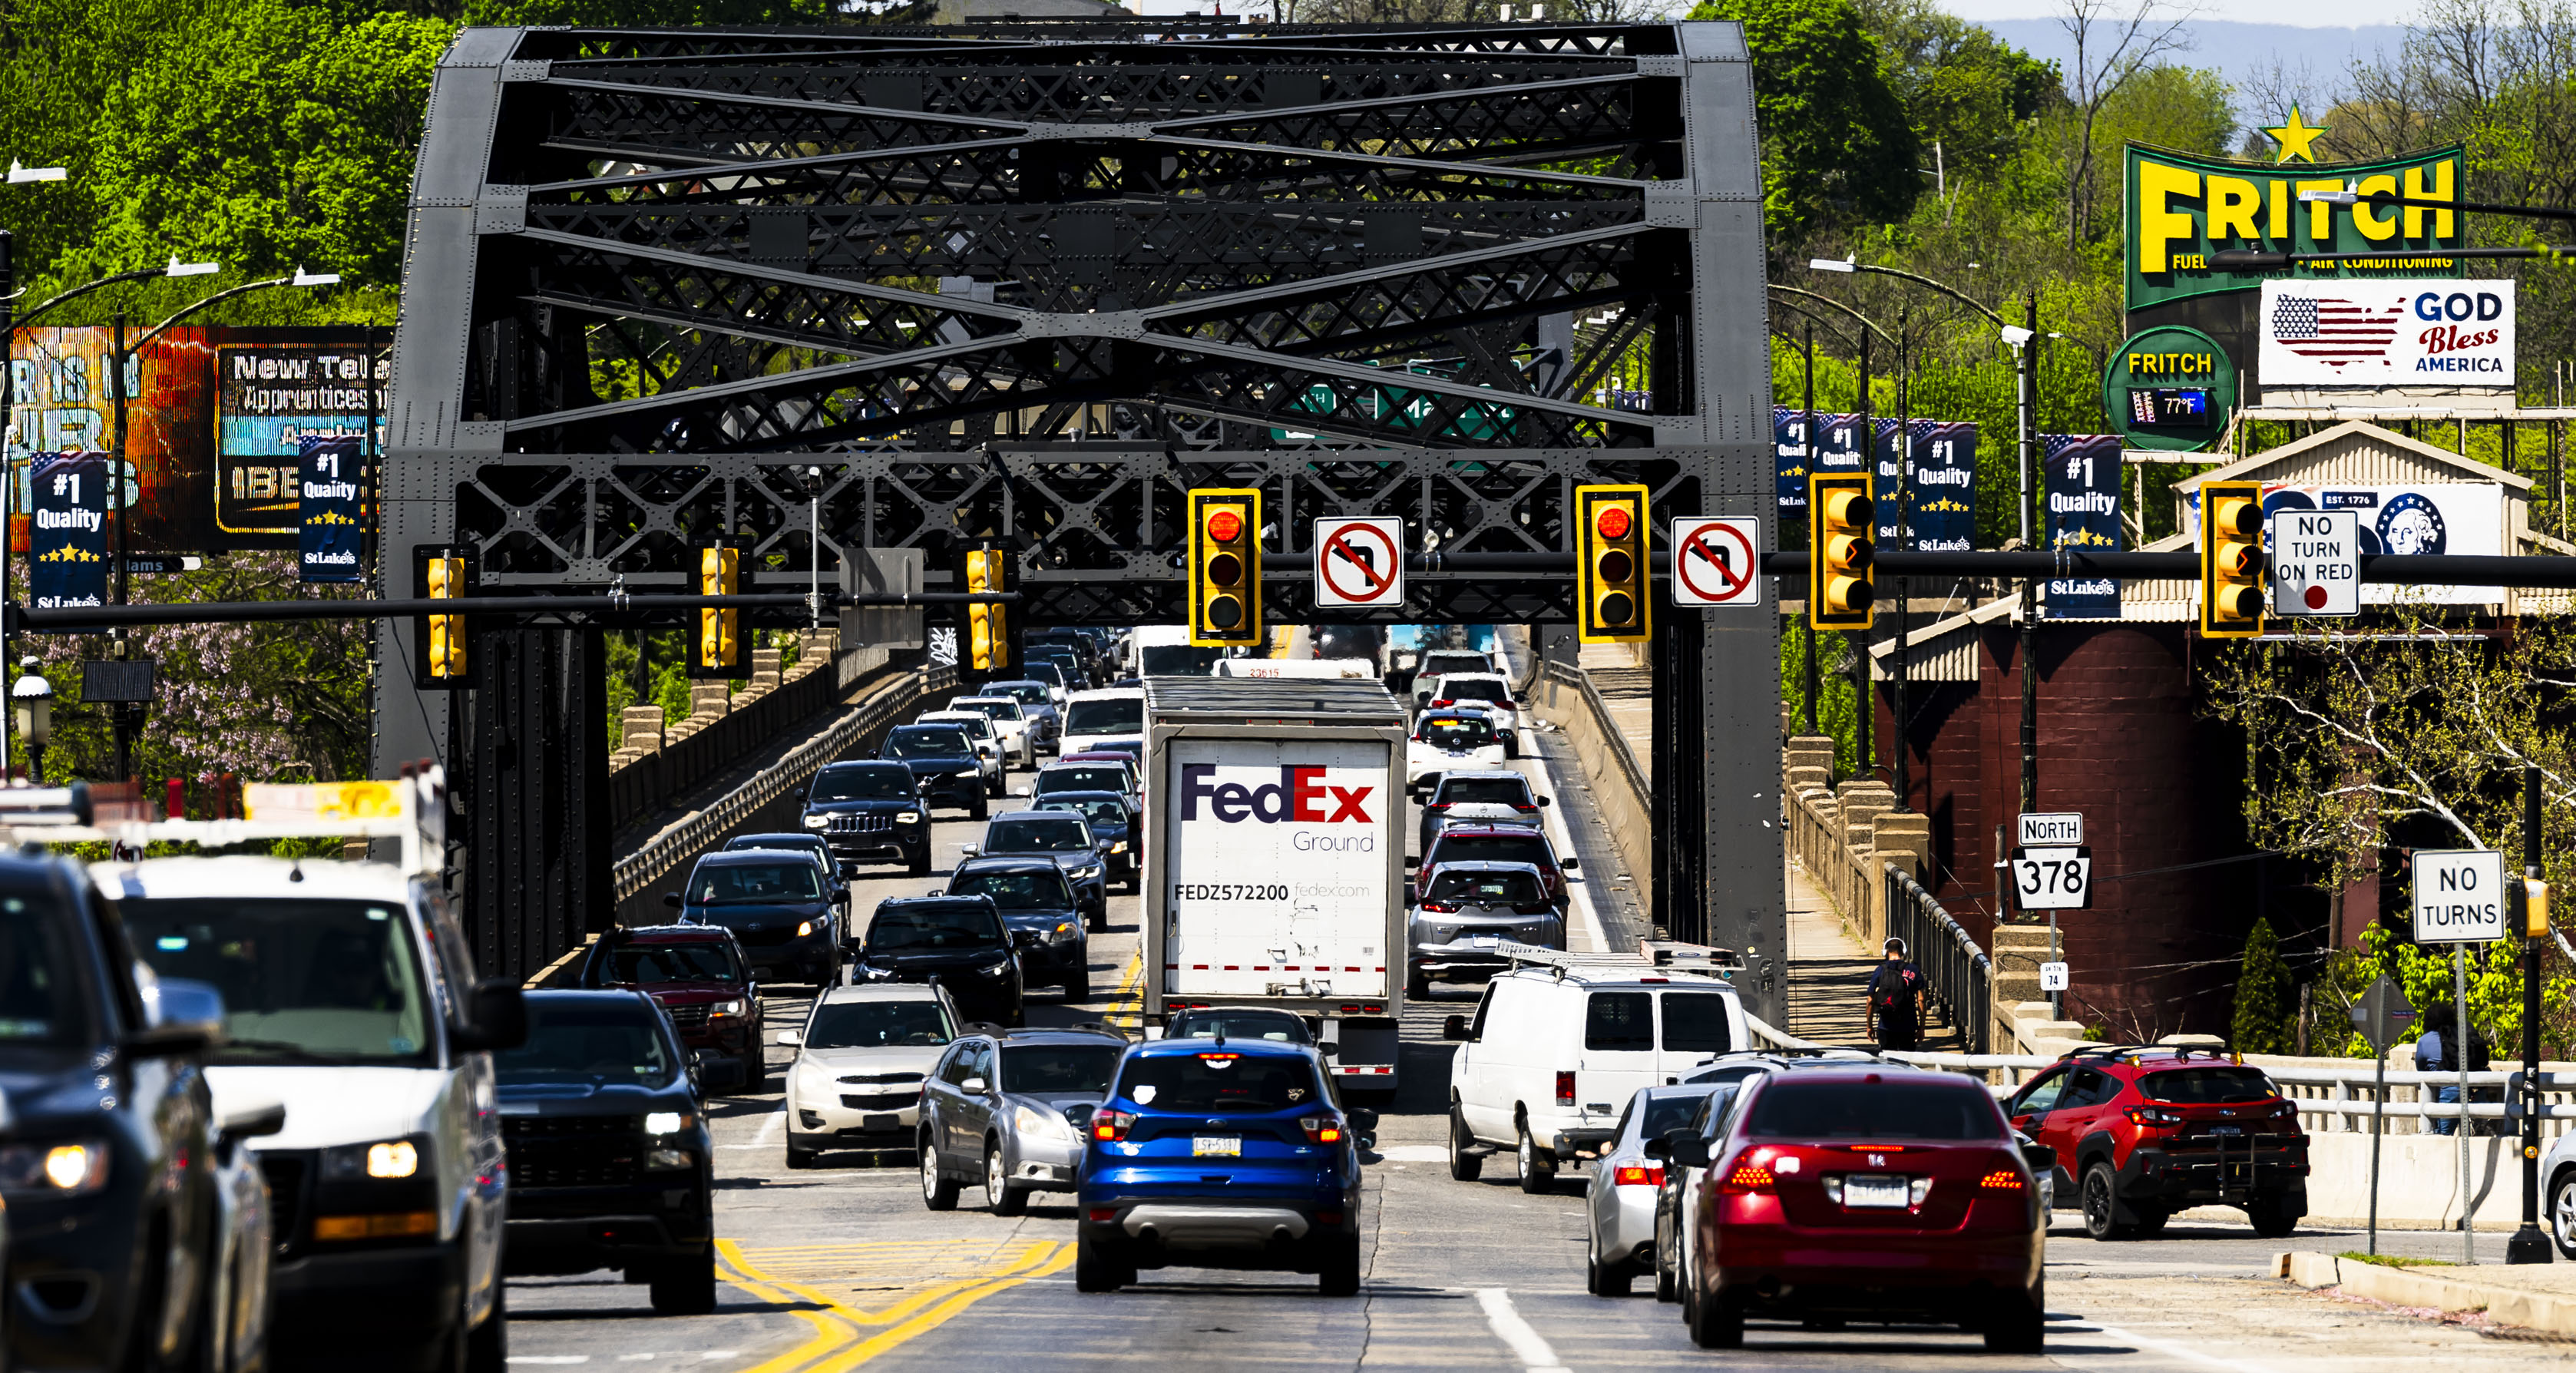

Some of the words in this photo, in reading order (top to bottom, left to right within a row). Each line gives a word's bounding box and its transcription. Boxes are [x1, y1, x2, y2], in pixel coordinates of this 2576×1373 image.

[2139, 158, 2455, 273] FRITCH
[2173, 254, 2207, 270] FUEL
[2415, 292, 2502, 322] GOD
[2419, 324, 2499, 356] Bless
[233, 356, 309, 379] New
[2128, 352, 2211, 374] FRITCH
[2416, 357, 2504, 372] AMERICA
[1787, 423, 1805, 442] #1
[1834, 428, 1852, 448] #1
[1822, 451, 1861, 466] Qualit
[1932, 440, 1953, 465] #1
[317, 453, 339, 478] #1
[2067, 457, 2093, 488] #1
[53, 473, 80, 504] #1
[1918, 468, 1971, 488] Quality
[303, 480, 356, 501] Quality
[2326, 495, 2345, 505] EST.
[2348, 495, 2370, 505] 1776
[2050, 491, 2116, 516] Quality
[37, 508, 101, 532] Quality
[2299, 516, 2333, 536] NO
[2291, 541, 2341, 558] TURN
[2279, 564, 2306, 581] ON
[2316, 564, 2353, 580] RED
[1250, 668, 1279, 678] 23615
[1181, 763, 1375, 824] FedEx
[2025, 819, 2078, 839] NORTH
[1293, 831, 1374, 852] Ground
[2022, 859, 2083, 895] 378
[2439, 866, 2477, 892] NO
[1175, 884, 1289, 902] FEDZ572200
[1294, 882, 1371, 898] fedex.com
[2422, 903, 2497, 926] TURNS
[2049, 974, 2058, 986] 74
